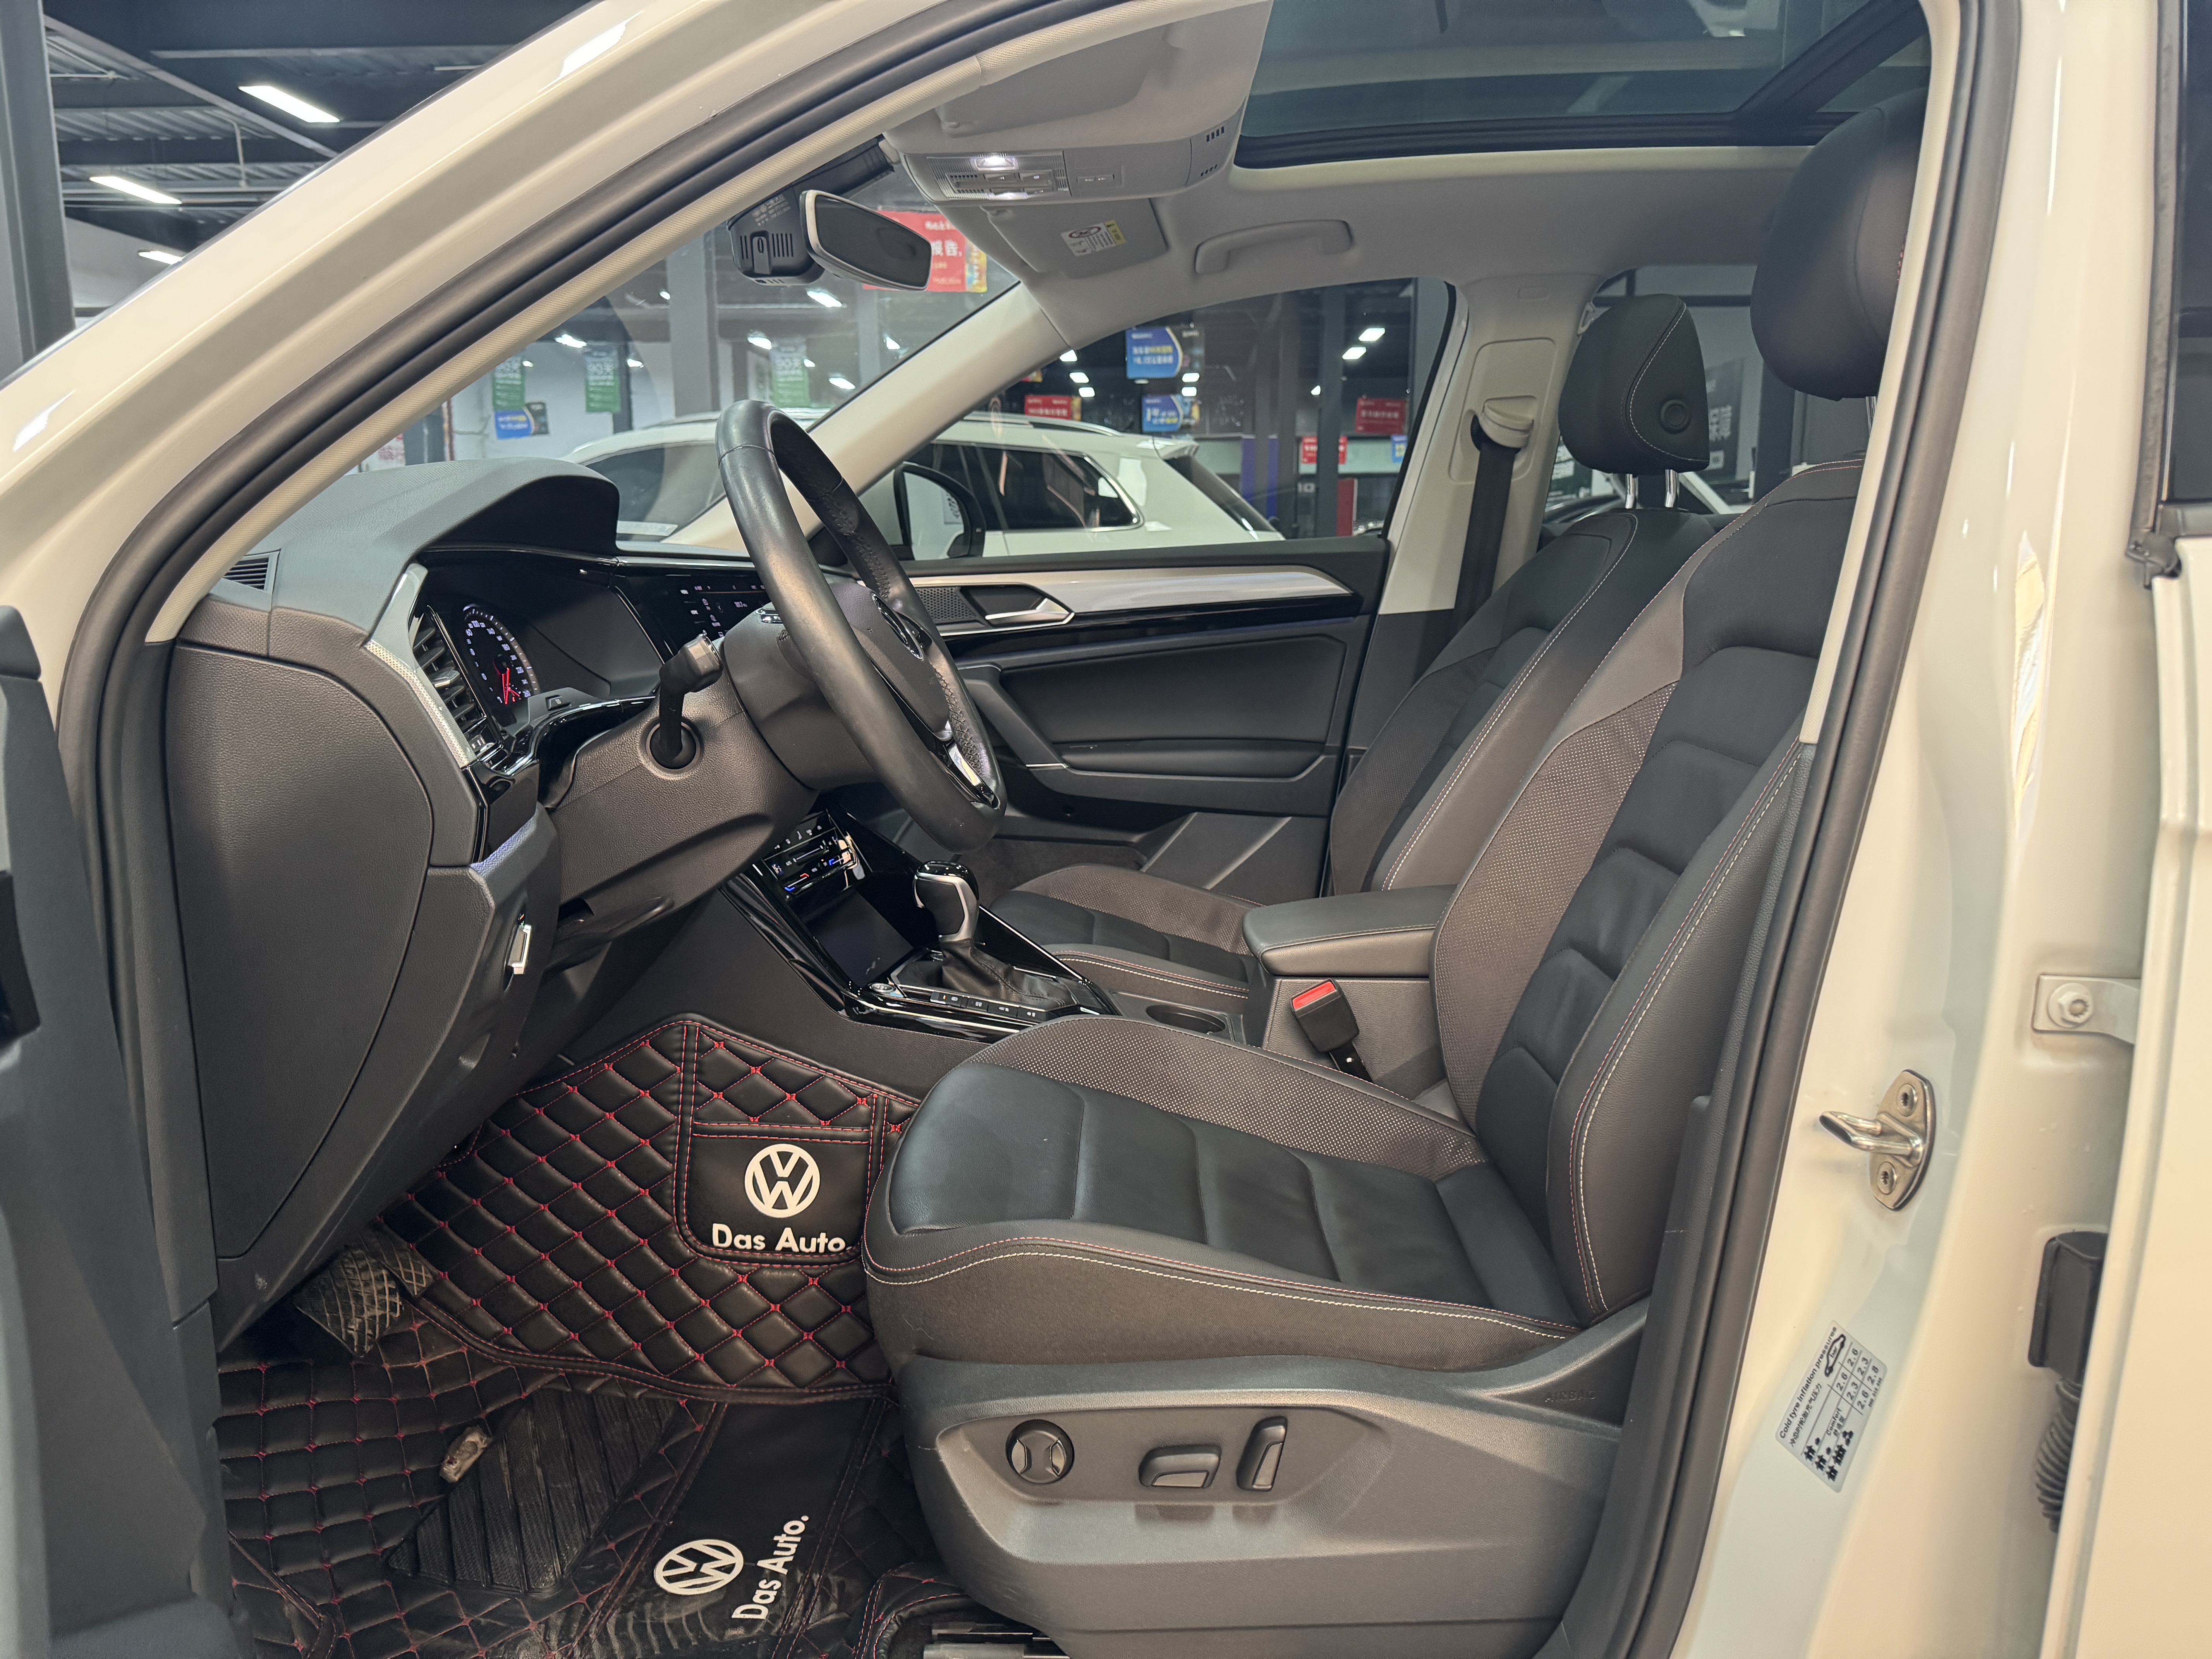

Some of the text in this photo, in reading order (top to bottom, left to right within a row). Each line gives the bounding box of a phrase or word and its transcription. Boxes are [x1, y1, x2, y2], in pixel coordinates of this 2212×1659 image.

[713, 1223, 766, 1250] Das
[1836, 1348, 1858, 1391] 2.6 2.6
[1847, 1357, 1869, 1401] 2.3 2.3
[1857, 1390, 1869, 1410] 2.6
[1867, 1366, 1879, 1384] 2.8
[1780, 1418, 1792, 1438] Cold
[1790, 1402, 1800, 1418] tyre
[1826, 1407, 1841, 1436] Comfort
[731, 1515, 809, 1620] Das Auto.
